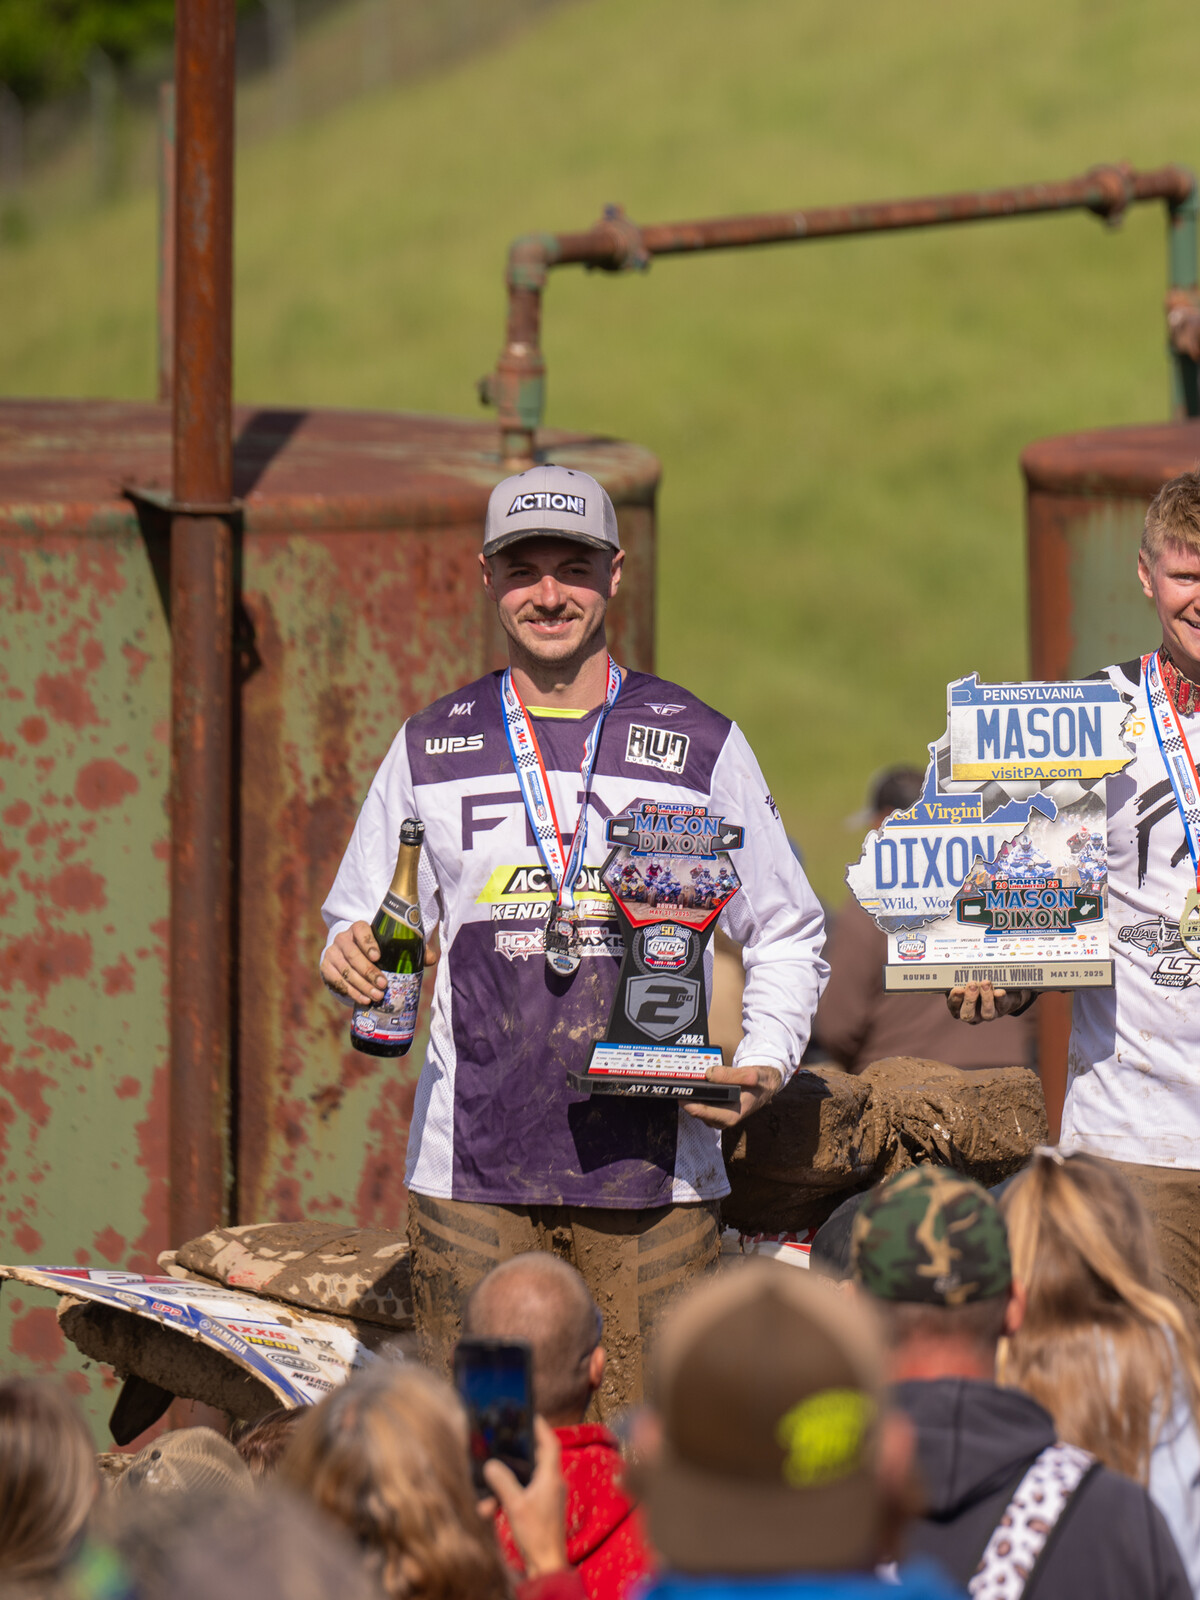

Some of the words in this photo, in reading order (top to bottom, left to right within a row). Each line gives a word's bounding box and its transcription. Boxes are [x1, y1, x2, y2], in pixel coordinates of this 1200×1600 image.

[509, 493, 579, 514] ACTION
[983, 687, 1085, 701] PENNSYLVANIA
[448, 700, 476, 718] MX
[1158, 709, 1174, 736] AMA
[513, 725, 530, 752] AMA
[976, 705, 1103, 760] MASON
[425, 733, 484, 755] WPS
[991, 766, 1083, 780] visitPA.com
[632, 813, 723, 837] MASON
[638, 831, 713, 855] DIXON
[874, 835, 995, 890] DIXON
[995, 881, 1008, 890] 20
[1047, 880, 1059, 889] 25
[882, 897, 918, 911] Wild,
[985, 889, 1078, 910] MASON
[991, 909, 1072, 930] DIXON
[661, 926, 675, 936] 50
[648, 941, 685, 951] GNCC
[903, 973, 931, 981] ROUND
[954, 969, 970, 983] ATV
[971, 968, 1008, 983] OVERALL
[1009, 968, 1044, 982] WINNER
[1152, 972, 1190, 983] LONESTAR
[1155, 978, 1186, 988] RACING
[676, 1033, 705, 1046] AMA
[628, 1084, 650, 1093] ATV
[671, 1087, 694, 1096] PRO
[150, 1301, 184, 1317] UPP
[209, 1324, 250, 1356] YAMAHA
